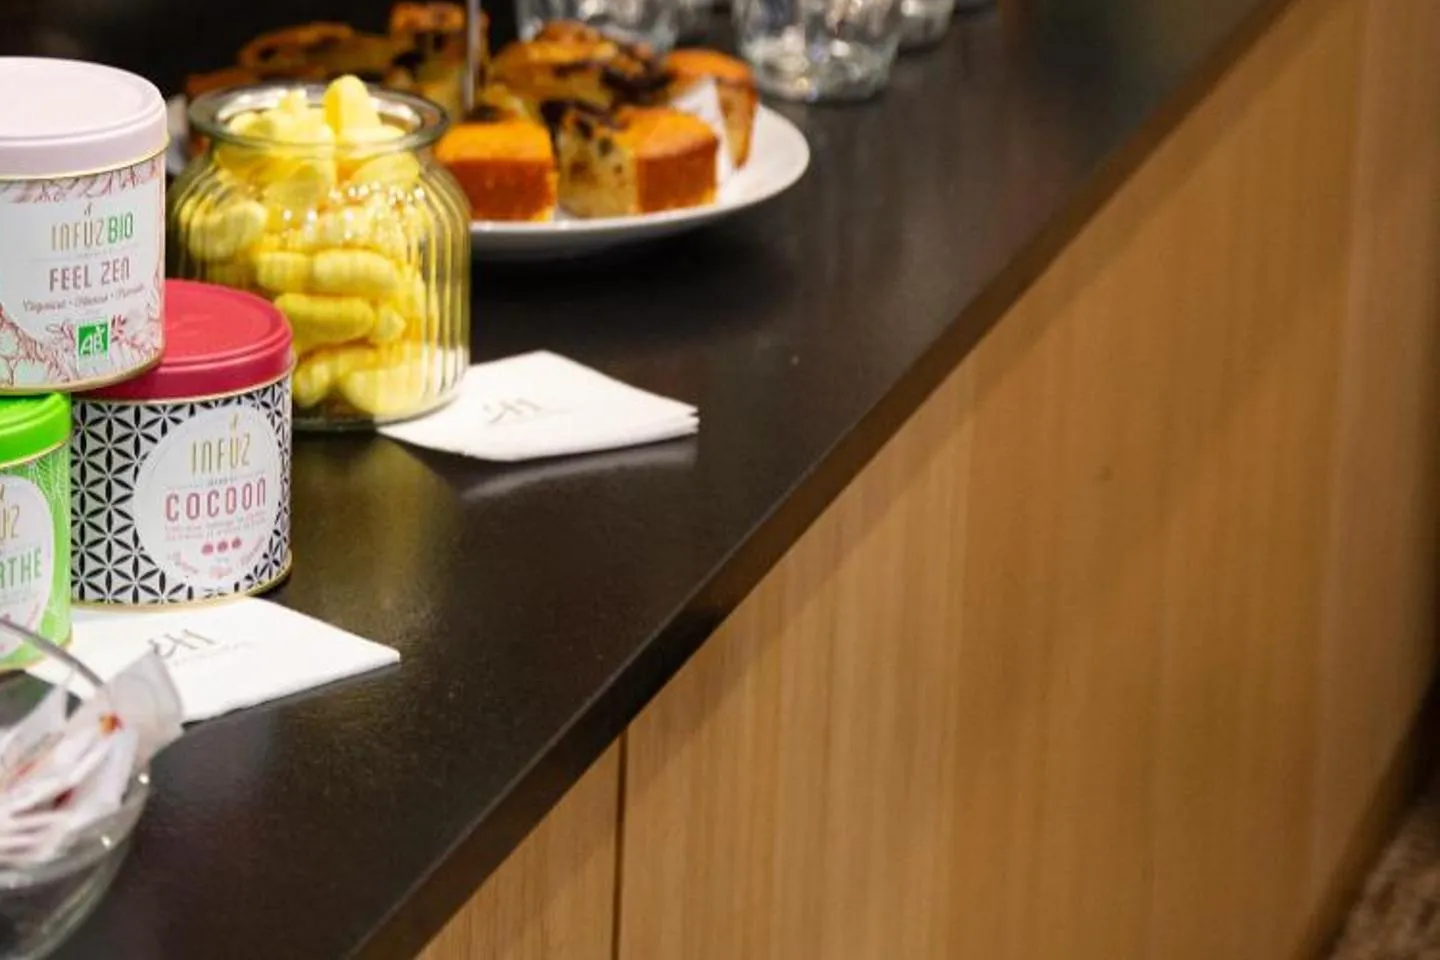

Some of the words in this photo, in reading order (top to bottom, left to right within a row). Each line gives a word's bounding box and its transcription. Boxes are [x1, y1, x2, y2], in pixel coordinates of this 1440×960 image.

[50, 265, 92, 292] FEEL
[101, 257, 130, 285] ZEN
[166, 476, 266, 522] COCOON
